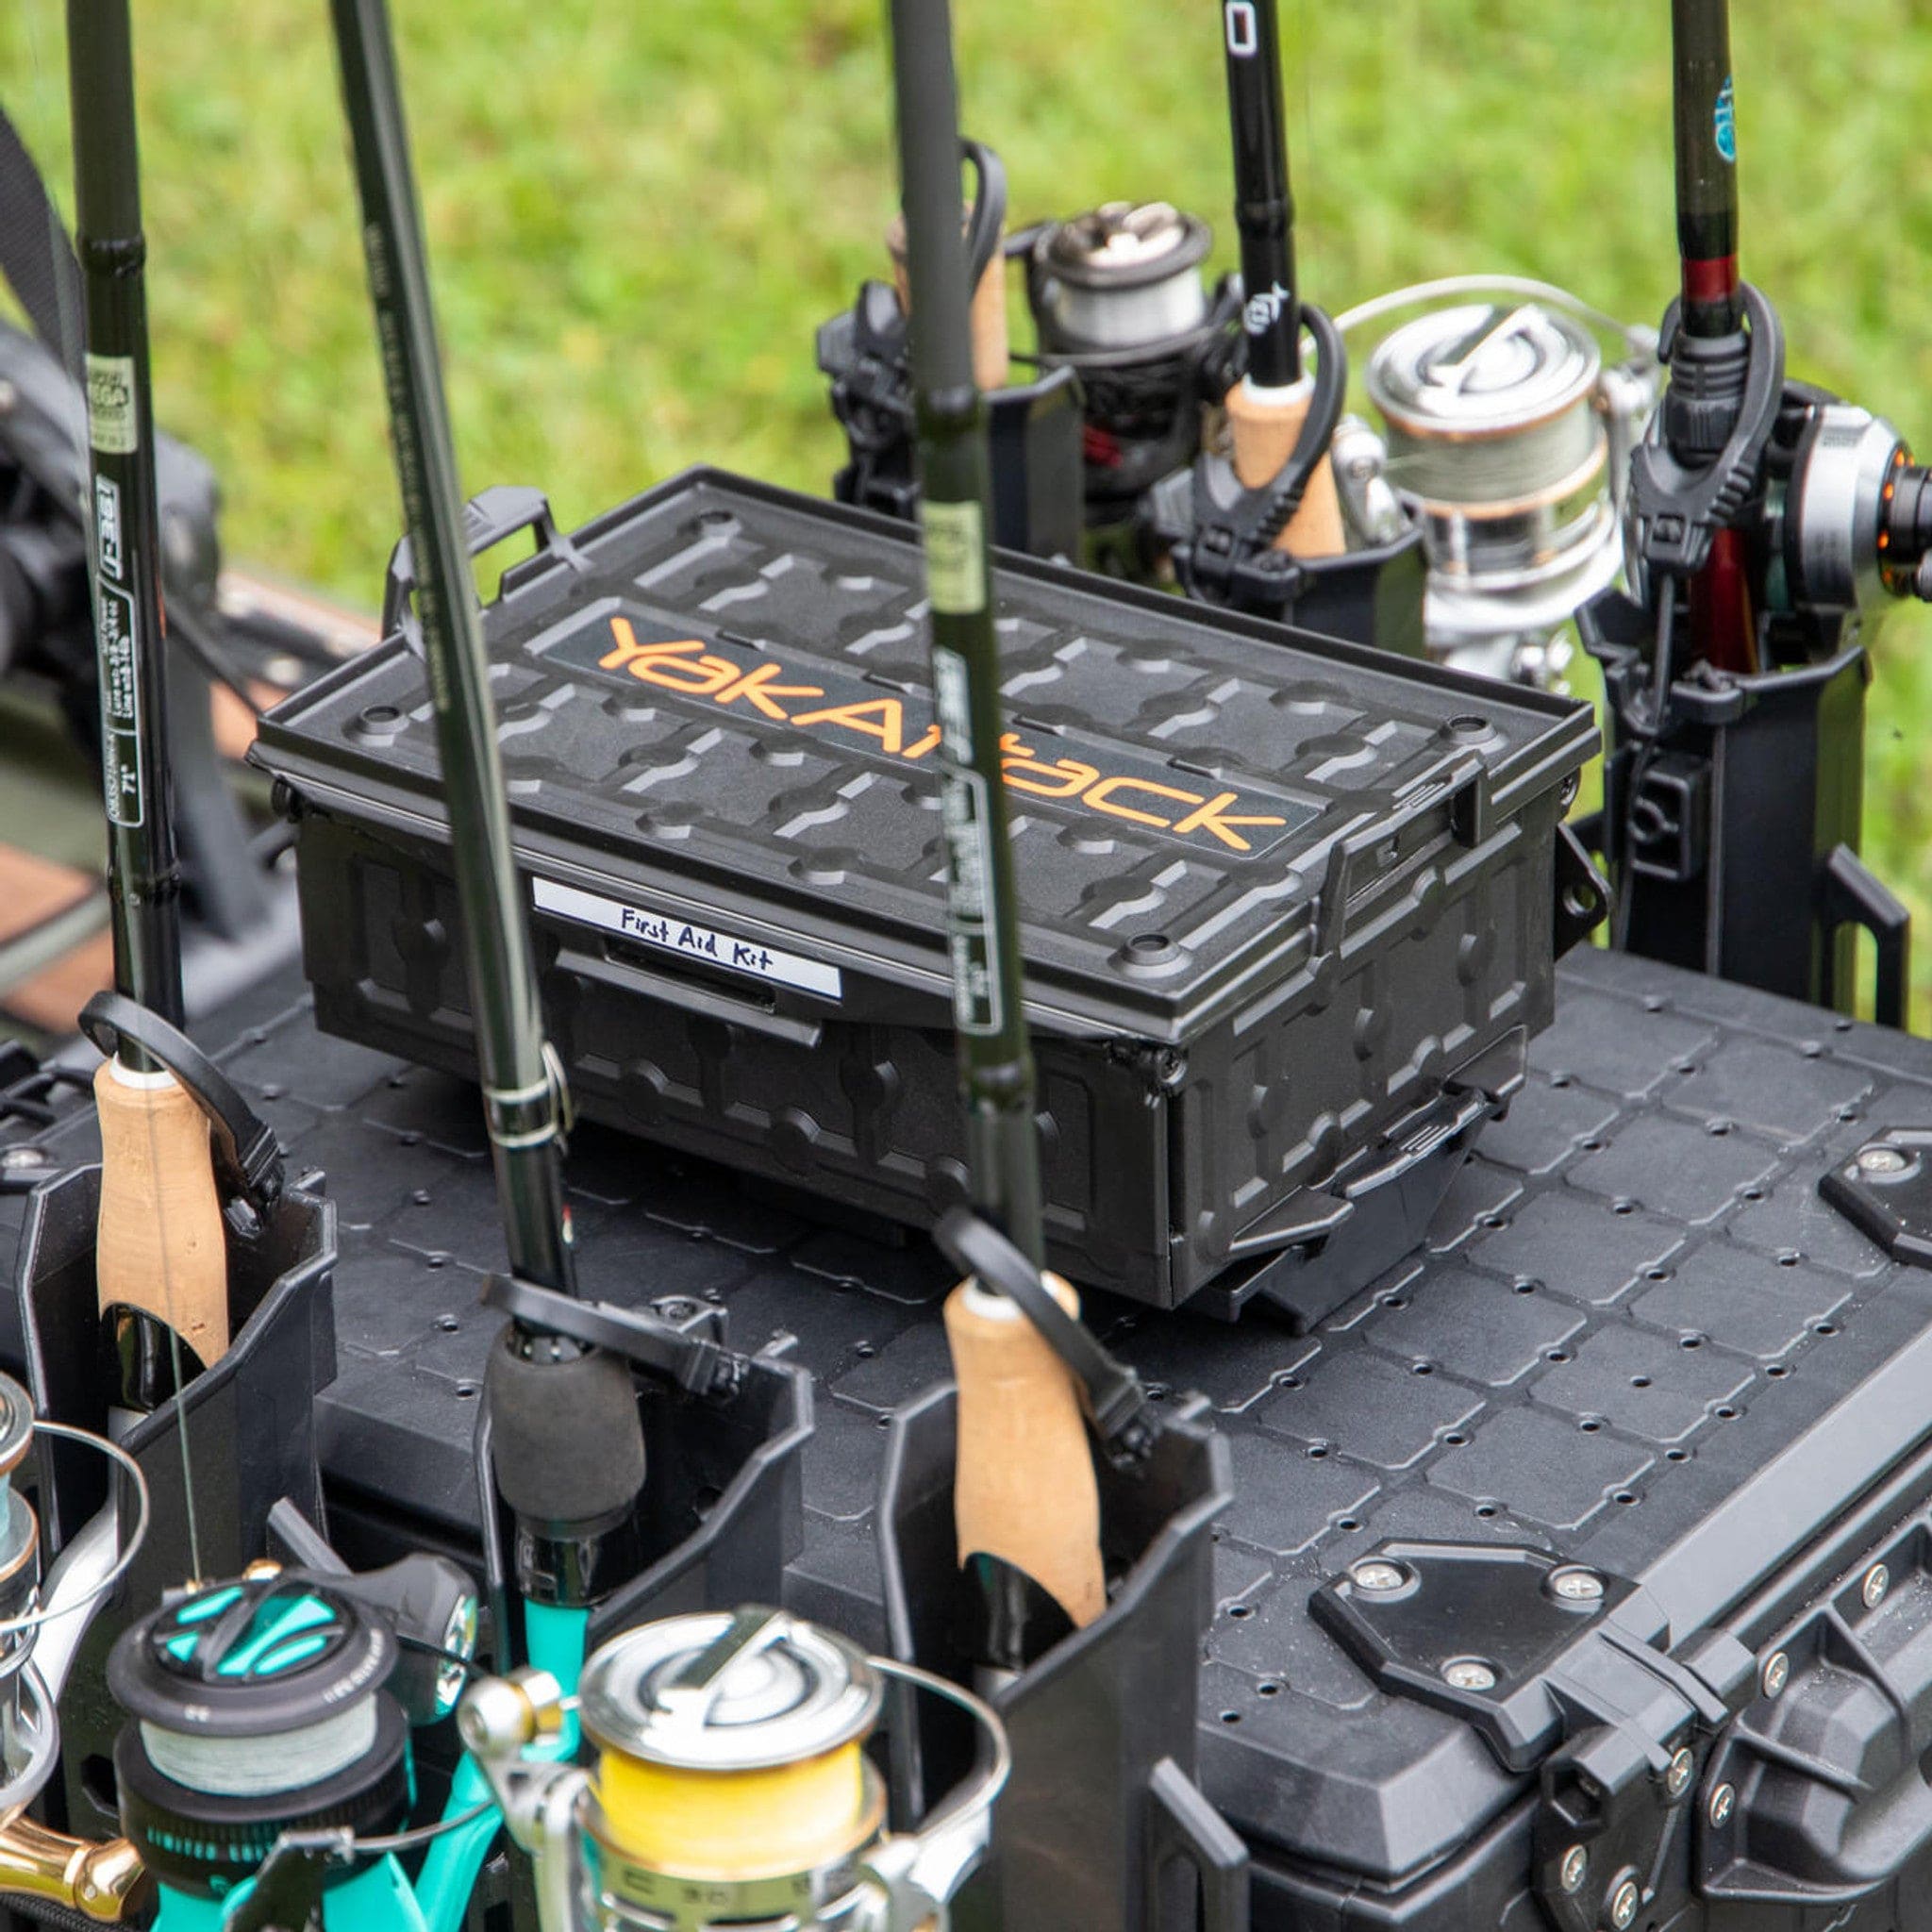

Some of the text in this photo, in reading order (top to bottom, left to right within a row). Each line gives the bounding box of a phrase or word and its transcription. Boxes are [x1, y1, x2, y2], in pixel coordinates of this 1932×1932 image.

[622, 908, 774, 971] First Aid Kit
